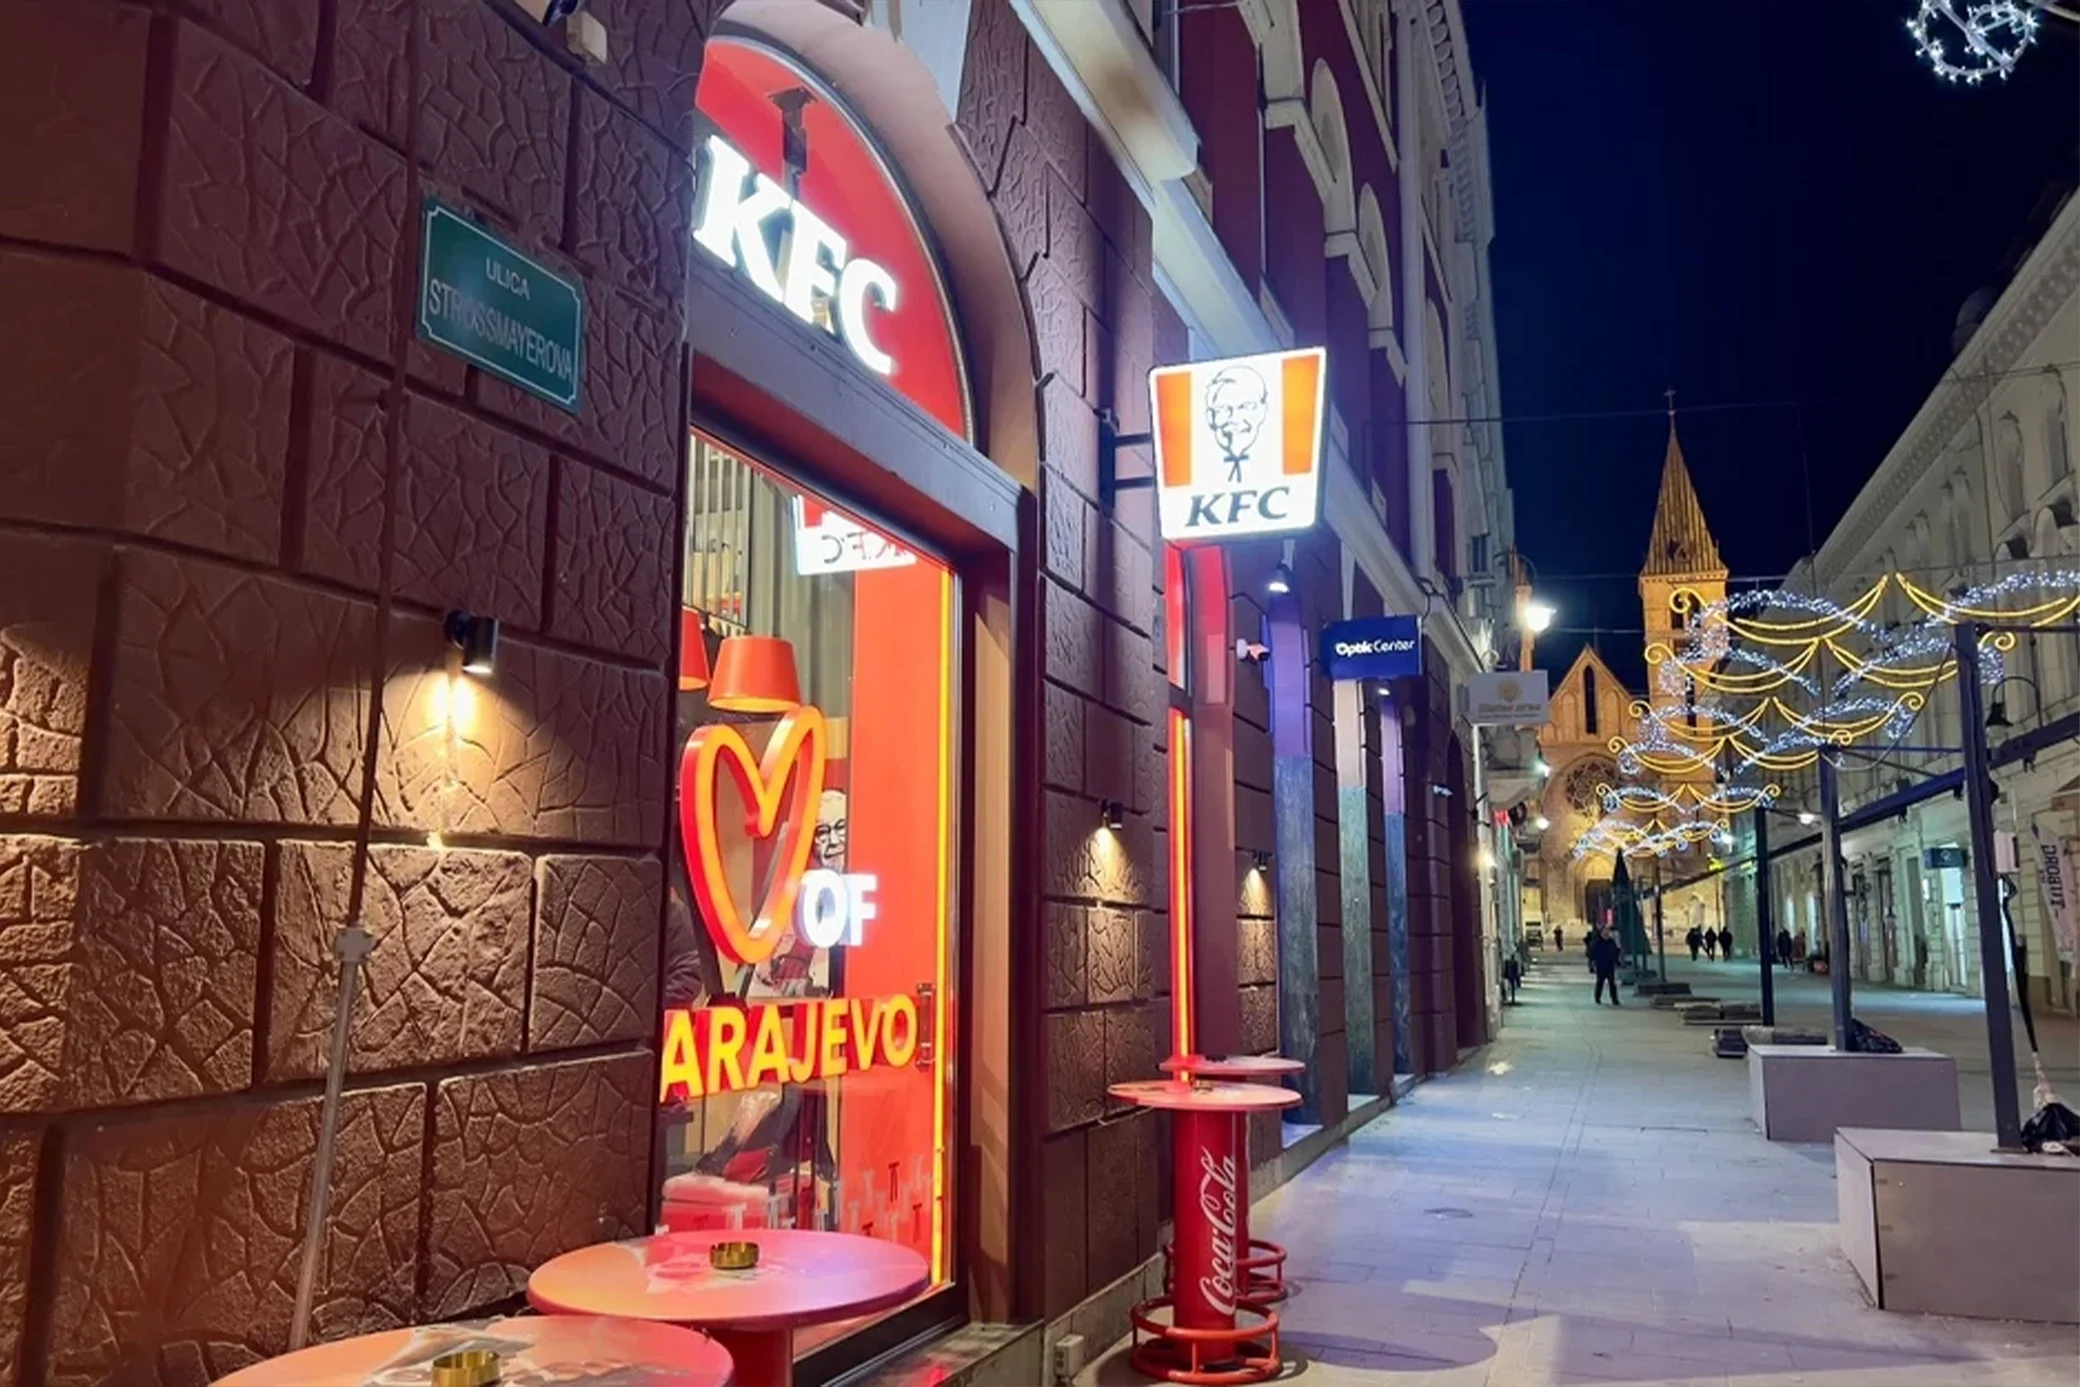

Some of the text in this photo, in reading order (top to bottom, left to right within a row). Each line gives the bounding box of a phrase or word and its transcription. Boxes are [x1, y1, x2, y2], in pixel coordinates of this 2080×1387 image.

[485, 257, 531, 300] ULICA
[693, 134, 897, 376] KFC
[428, 278, 573, 382] STROSSMAYEROVA
[1185, 486, 1291, 528] KFC
[1373, 639, 1416, 652] Center
[801, 868, 879, 948] OF
[659, 993, 918, 1104] ARAJEVO
[1199, 1145, 1237, 1317] Coca-Cola
